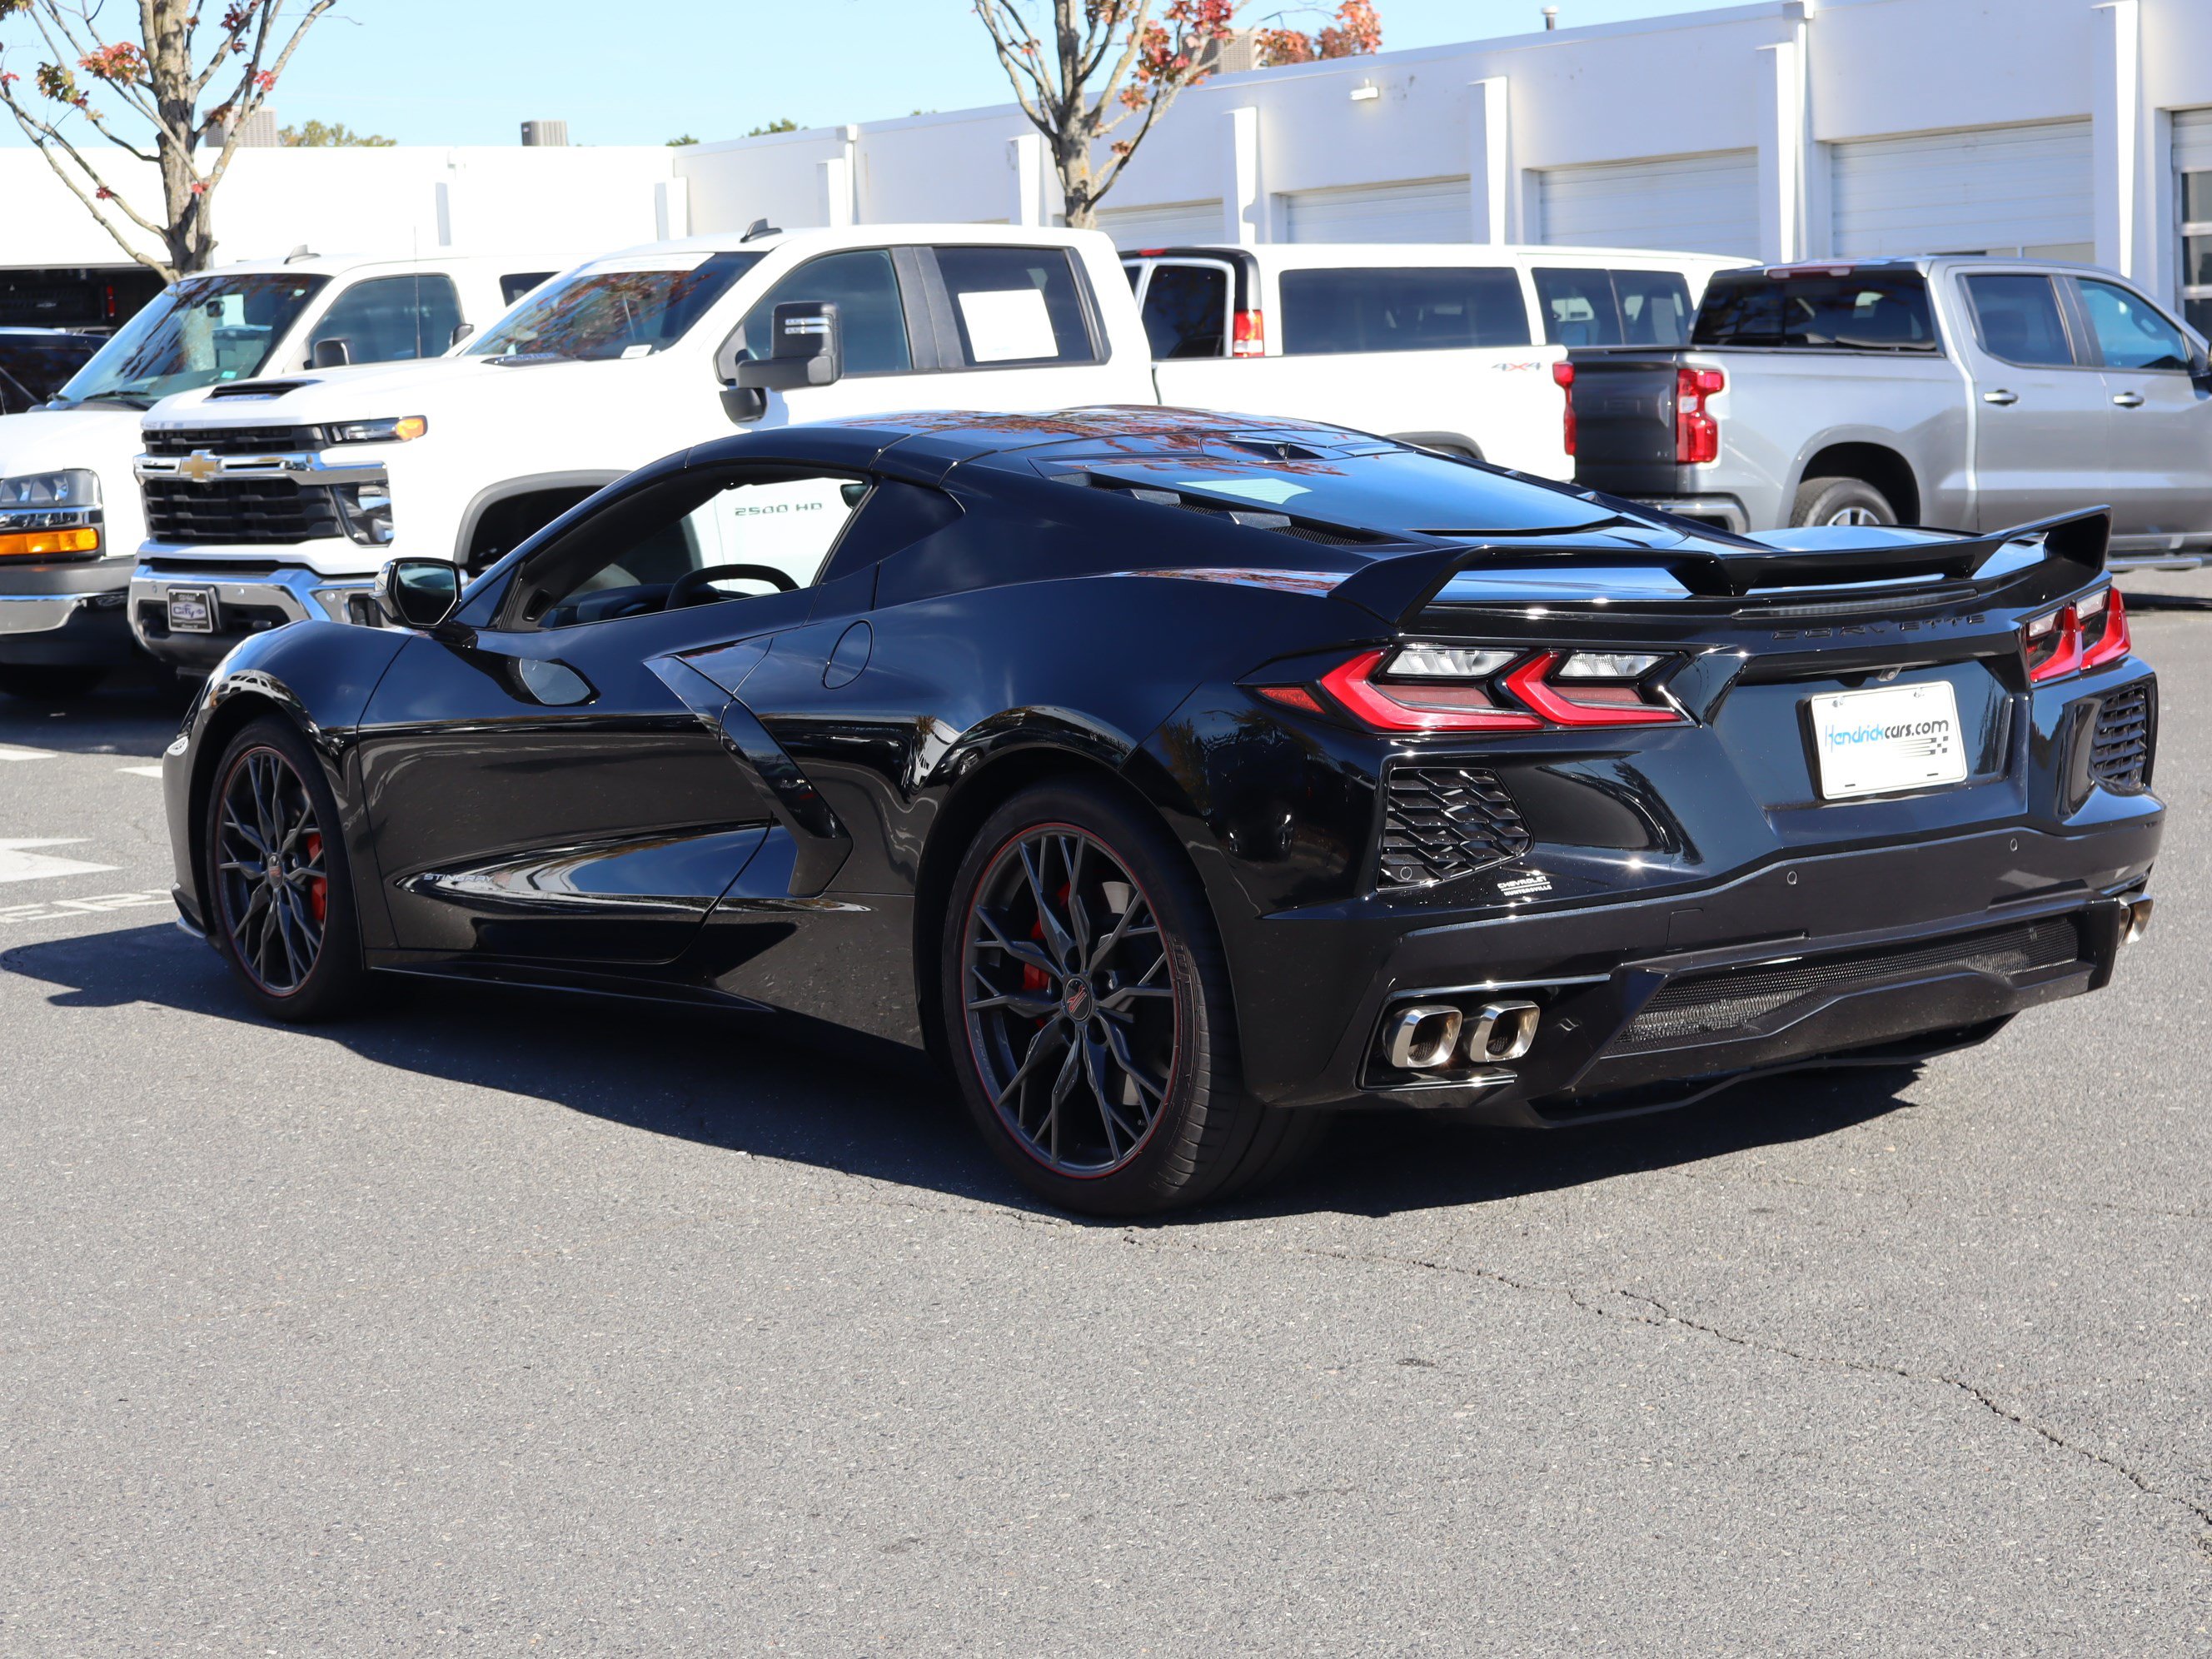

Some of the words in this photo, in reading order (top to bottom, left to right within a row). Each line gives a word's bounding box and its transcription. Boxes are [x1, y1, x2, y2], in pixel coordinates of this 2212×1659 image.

[735, 504, 788, 516] 2500
[795, 502, 822, 511] HD
[1771, 614, 1985, 640] CORVETTE
[1824, 719, 1950, 753] Hendrickcars.com
[423, 872, 495, 882] STINGRAY
[1497, 875, 1547, 889] CHEVROLET
[1503, 884, 1553, 896] HUNTERSVILLE
